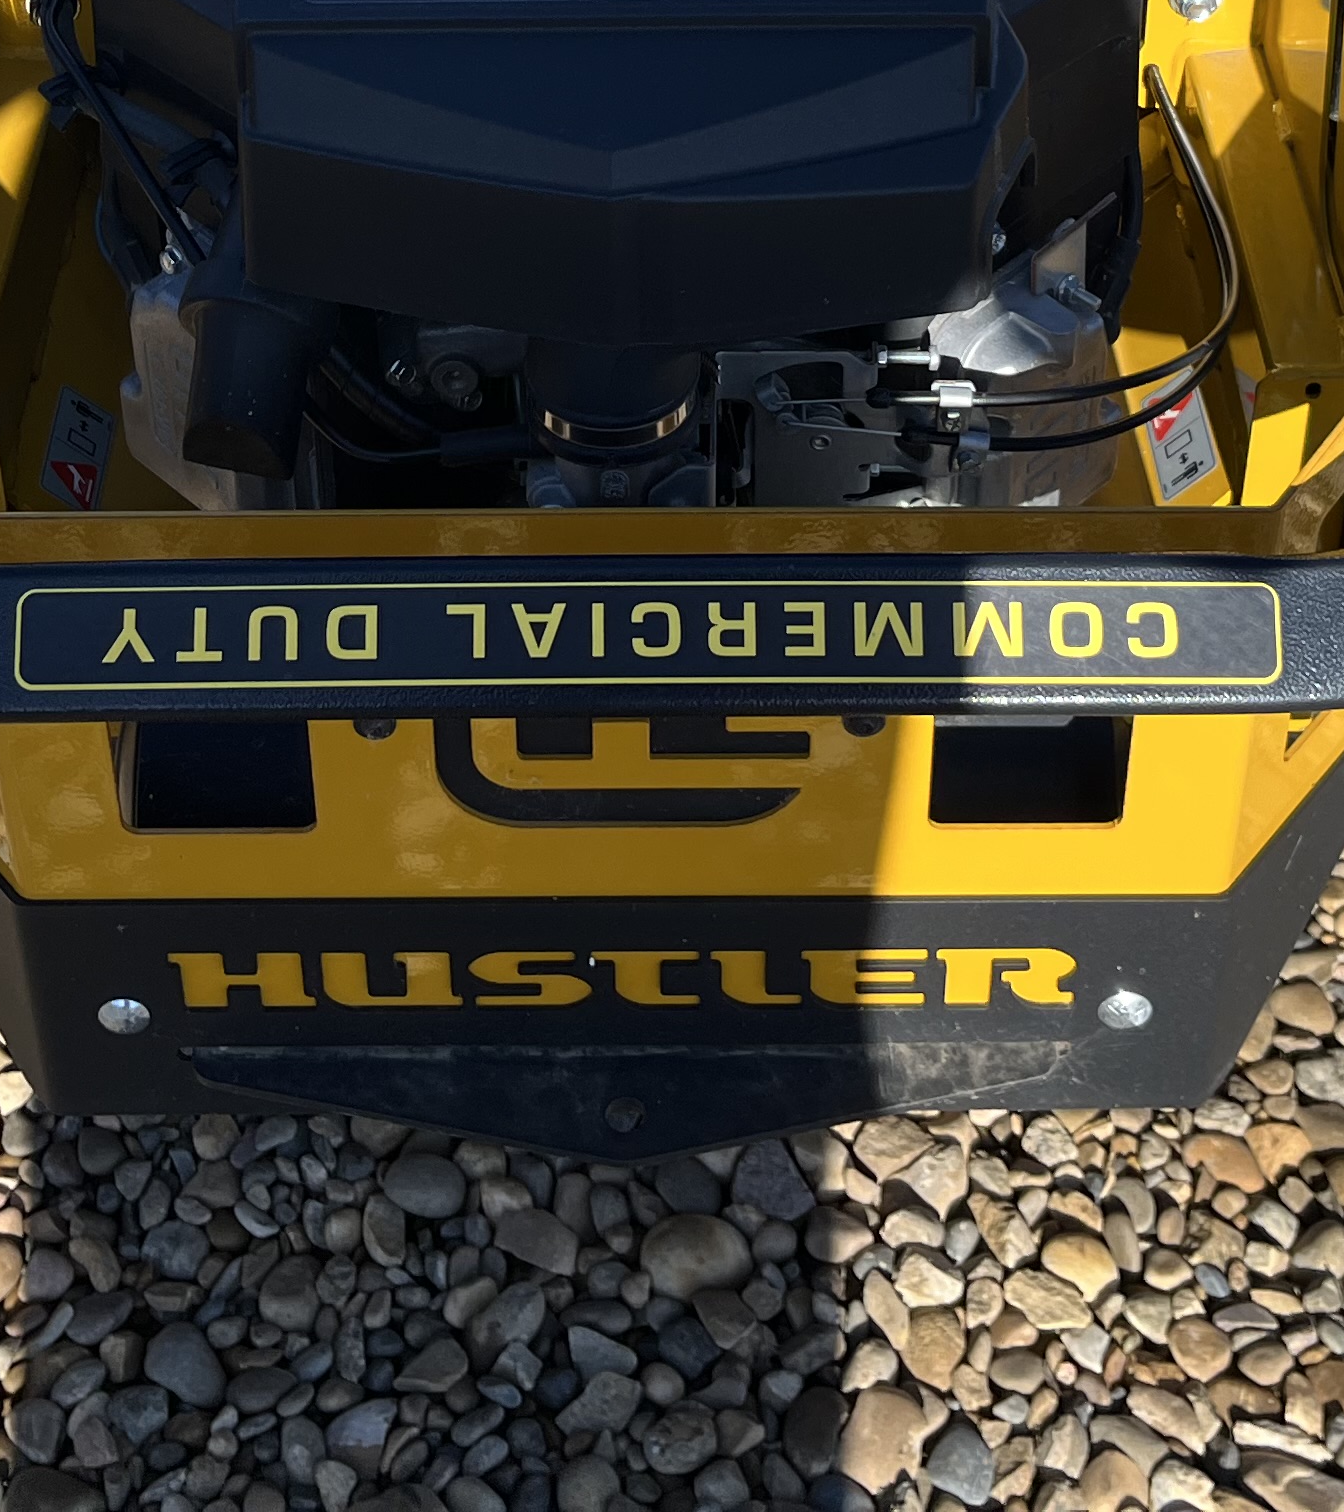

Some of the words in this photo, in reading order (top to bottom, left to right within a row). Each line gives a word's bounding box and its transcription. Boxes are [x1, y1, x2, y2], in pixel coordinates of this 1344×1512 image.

[103, 605, 378, 663] DUTY
[447, 601, 1180, 660] COMMERCIAL
[167, 948, 1077, 1008] HUSTLER
